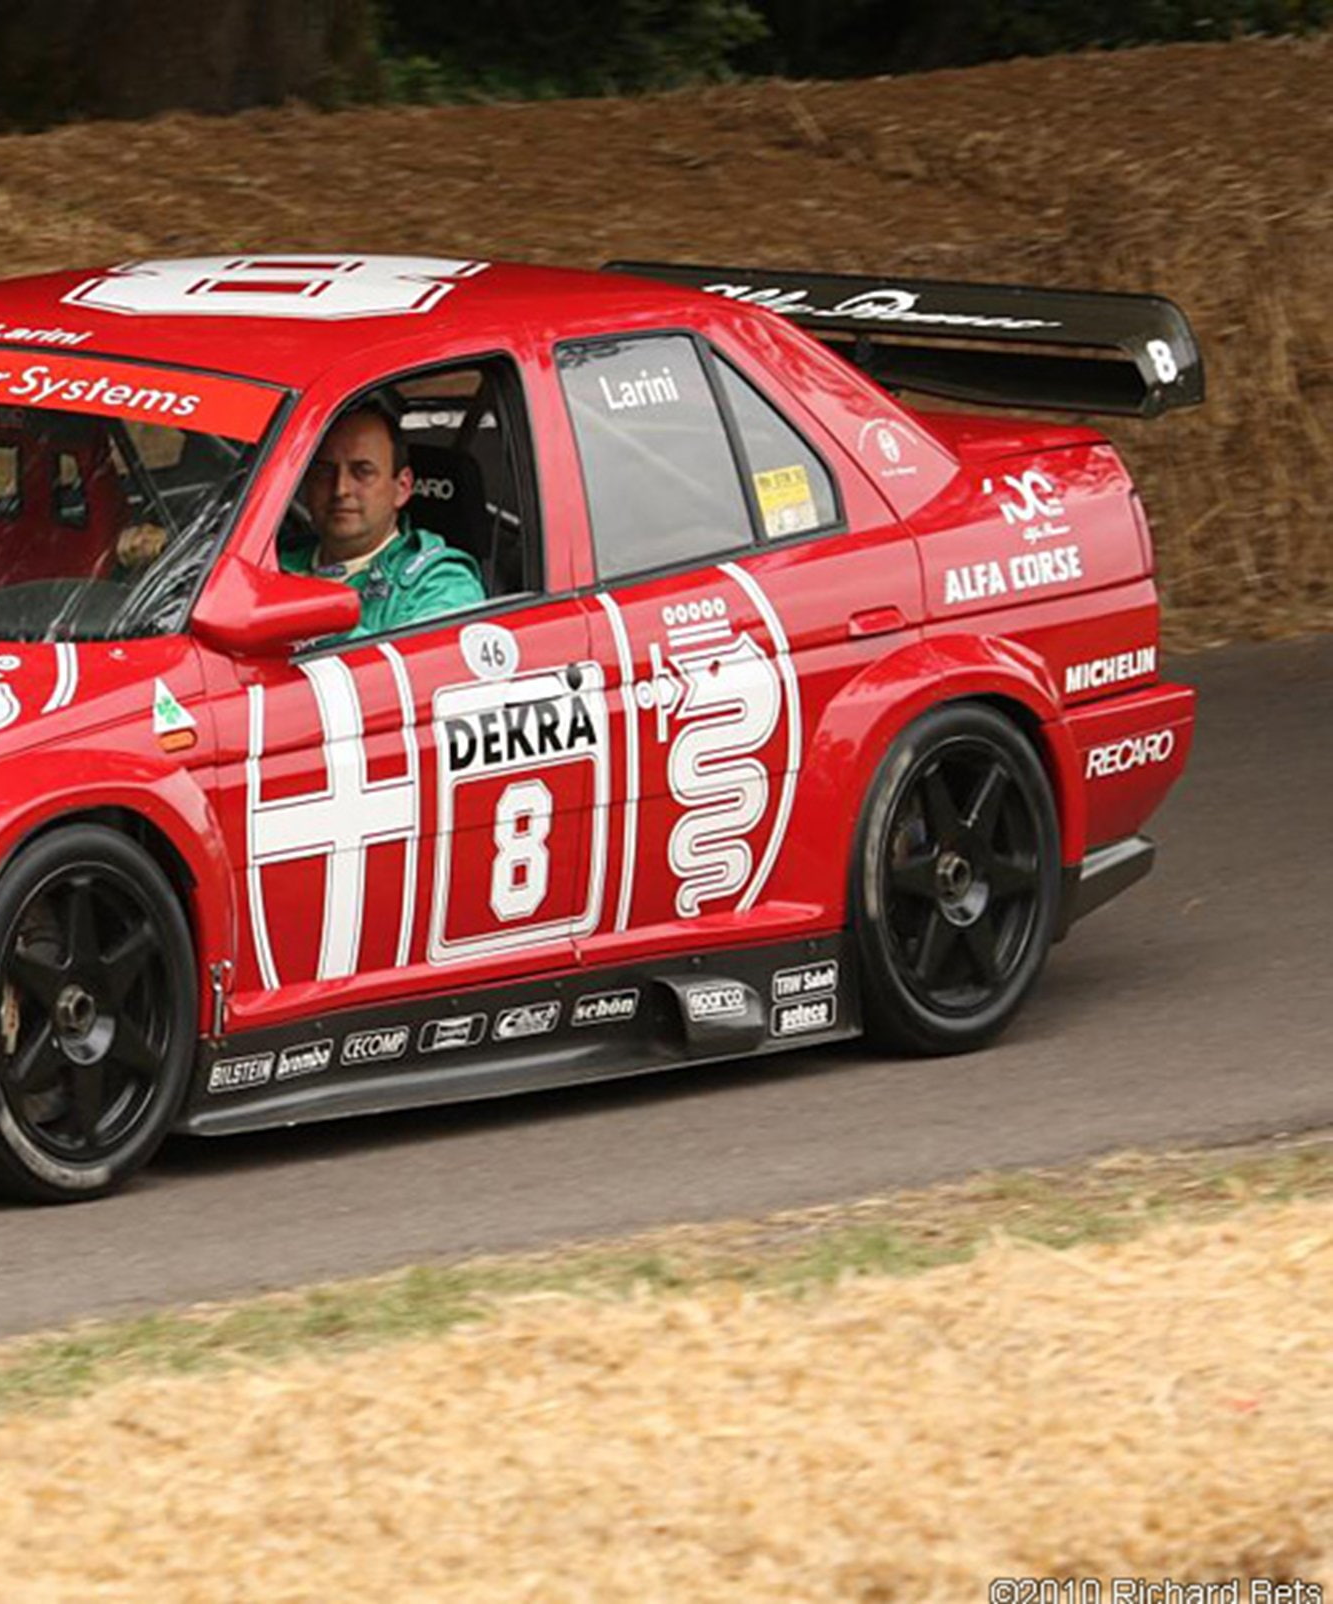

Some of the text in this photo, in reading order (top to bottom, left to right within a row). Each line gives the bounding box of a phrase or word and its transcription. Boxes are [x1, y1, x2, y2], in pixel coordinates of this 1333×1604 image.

[1146, 339, 1178, 384] 8
[7, 365, 201, 417] Systems
[598, 366, 680, 411] Larini
[943, 545, 1082, 604] ALFA CORSE
[480, 640, 505, 667] 46
[1065, 647, 1156, 693] MICHELIN
[445, 694, 597, 772] DEKRA
[1085, 730, 1175, 780] RECARO
[489, 778, 553, 922] 8
[211, 1059, 272, 1087] BILSTEIN
